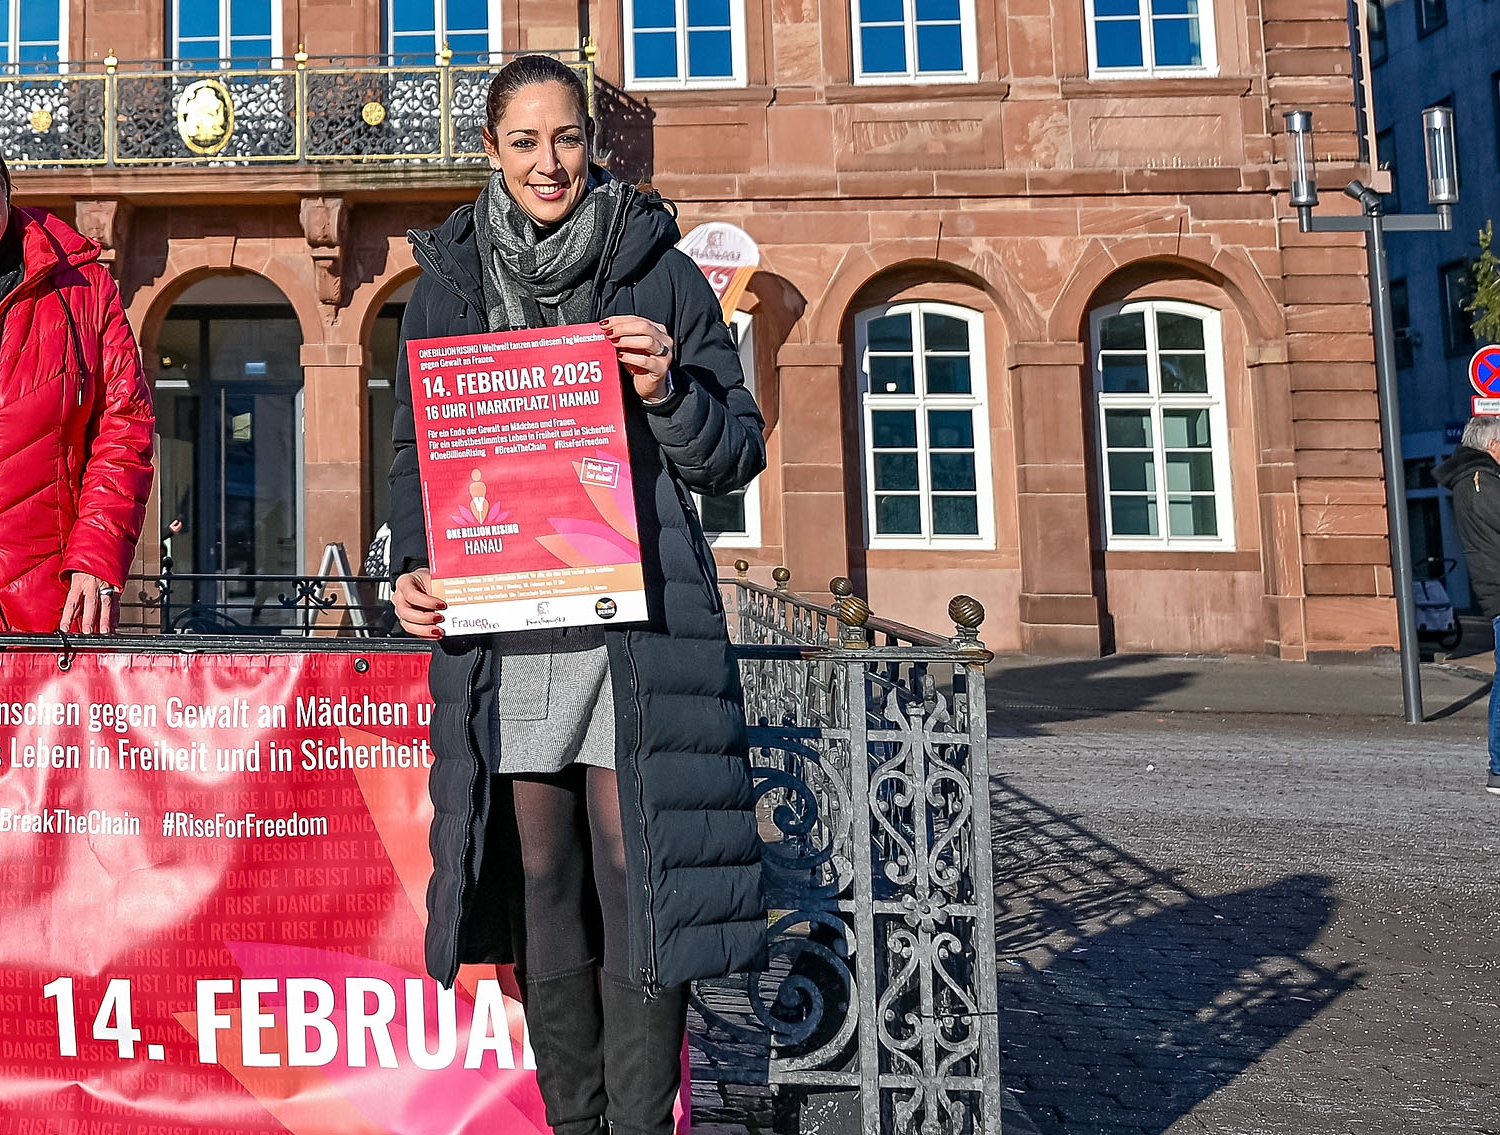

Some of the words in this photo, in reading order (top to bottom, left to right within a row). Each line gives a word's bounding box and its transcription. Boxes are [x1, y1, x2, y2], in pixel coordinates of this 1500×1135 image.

[419, 349, 433, 359] ONE
[433, 347, 456, 358] BILLION
[456, 345, 478, 355] RISING
[483, 342, 509, 353] Weltweit
[539, 339, 561, 347] diesem
[562, 337, 573, 346] Tag
[573, 334, 605, 345] Menschen
[440, 358, 462, 368] Gewalt
[422, 376, 451, 399] 14.
[456, 366, 546, 395] FEBRUAR
[551, 360, 602, 386] 2025
[425, 405, 438, 420] 16
[442, 402, 467, 419] UHR
[477, 395, 549, 416] MARKTPLATZ
[558, 390, 599, 408] HANAU
[428, 429, 438, 439] Für
[439, 429, 449, 438] ein
[450, 427, 465, 437] Ende
[467, 426, 477, 435] der
[478, 424, 500, 434] Gewalt
[511, 421, 539, 432] Mädchen
[540, 420, 552, 429] und
[553, 418, 576, 428] Frauen.
[429, 440, 439, 450] Für
[440, 440, 450, 448] ein
[451, 434, 508, 448] selbstbestimmtes
[509, 433, 527, 443] Leben
[528, 432, 534, 441] in
[536, 430, 560, 441] Freiheit
[561, 428, 573, 437] und
[574, 427, 580, 436] in
[430, 448, 486, 461] #OneBillionRising
[494, 443, 547, 455] #BreakTheChain
[554, 437, 609, 449] #RiseForFreedom
[446, 528, 461, 539] ONE
[462, 525, 491, 538] BILLION
[492, 524, 519, 536] RISING
[464, 538, 503, 555] HANAU
[88, 703, 157, 733] gegen
[165, 695, 249, 730] Gewalt
[258, 702, 286, 728] an
[296, 695, 408, 728] Mädchen
[417, 703, 436, 726] u
[10, 736, 80, 769] Leben
[89, 741, 110, 770] in
[117, 737, 207, 773] Freiheit
[216, 740, 260, 772] und
[270, 739, 292, 771] in
[162, 812, 328, 838] #RiseForFreedom
[252, 841, 307, 862] RESIST
[322, 840, 358, 860] RISE
[226, 870, 279, 889] DANCE
[294, 867, 349, 887] RESIST
[225, 896, 261, 915] RISE
[43, 976, 165, 1061] 14.
[196, 976, 538, 1071] FEBRUA
